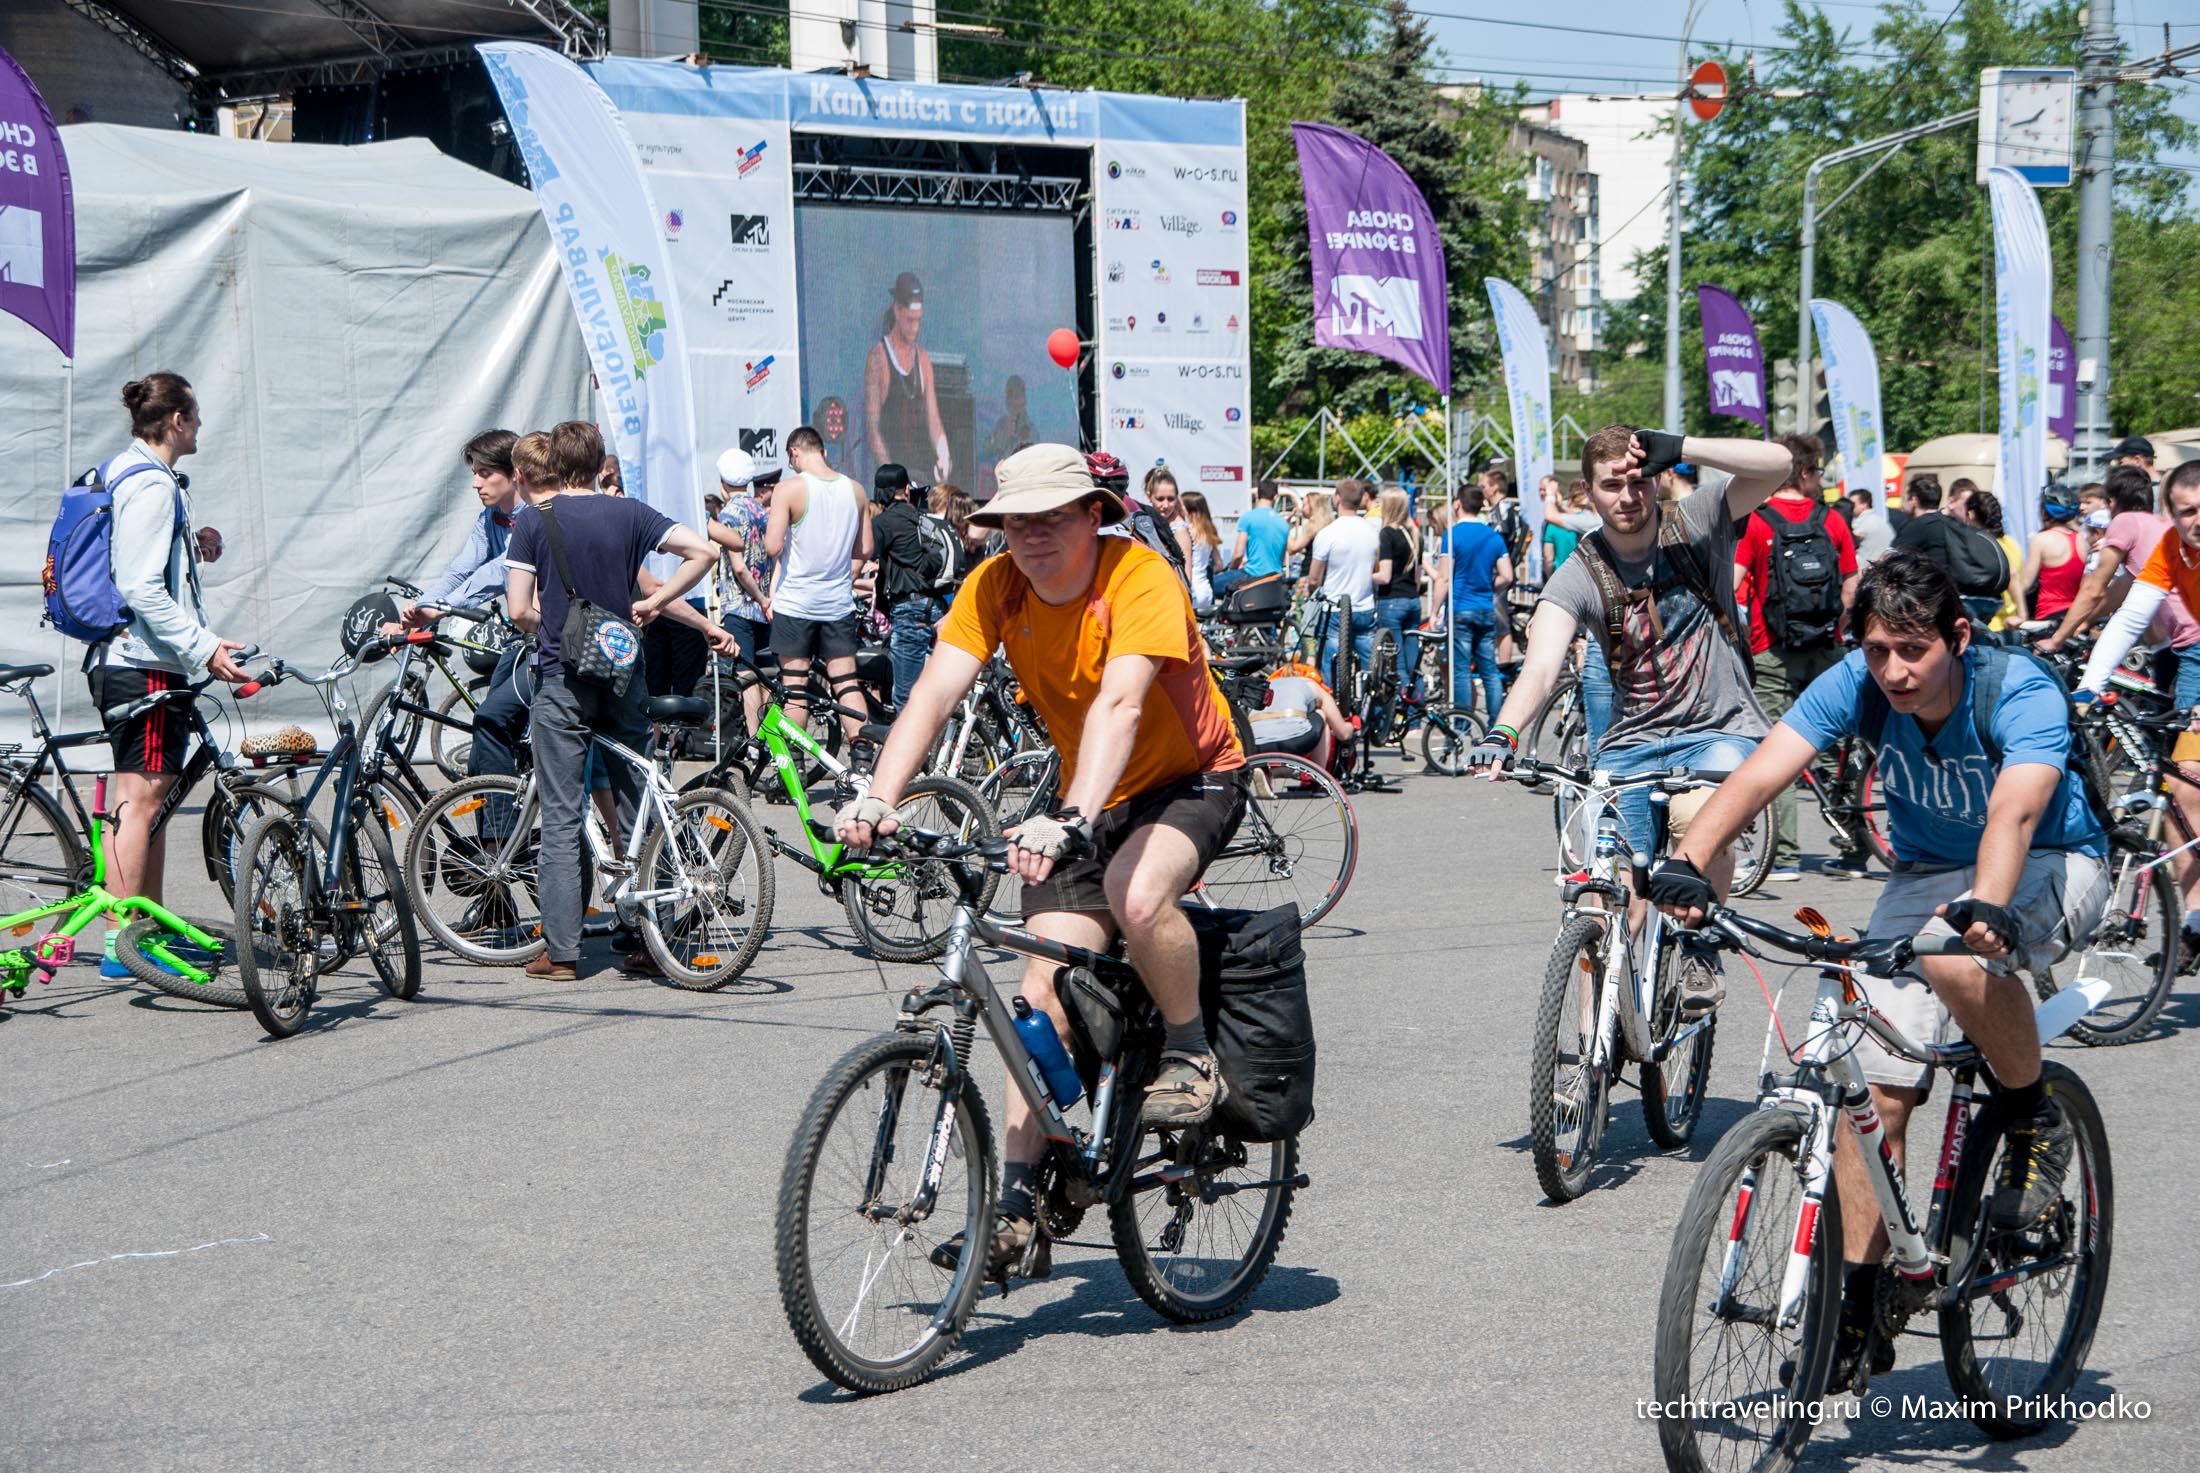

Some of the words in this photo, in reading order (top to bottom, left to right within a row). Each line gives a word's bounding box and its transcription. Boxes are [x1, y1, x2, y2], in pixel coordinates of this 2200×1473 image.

[809, 81, 951, 122] Катайся
[960, 102, 977, 124] с
[1173, 166, 1238, 182] w-o-s.ru
[731, 214, 770, 245] MTV
[1160, 215, 1202, 238] Village
[1178, 365, 1242, 379] w-o-s.ru
[1164, 413, 1206, 435] Village
[739, 428, 777, 458] MTV
[1948, 1106, 1969, 1167] HARO
[1888, 1156, 1918, 1231] HARO
